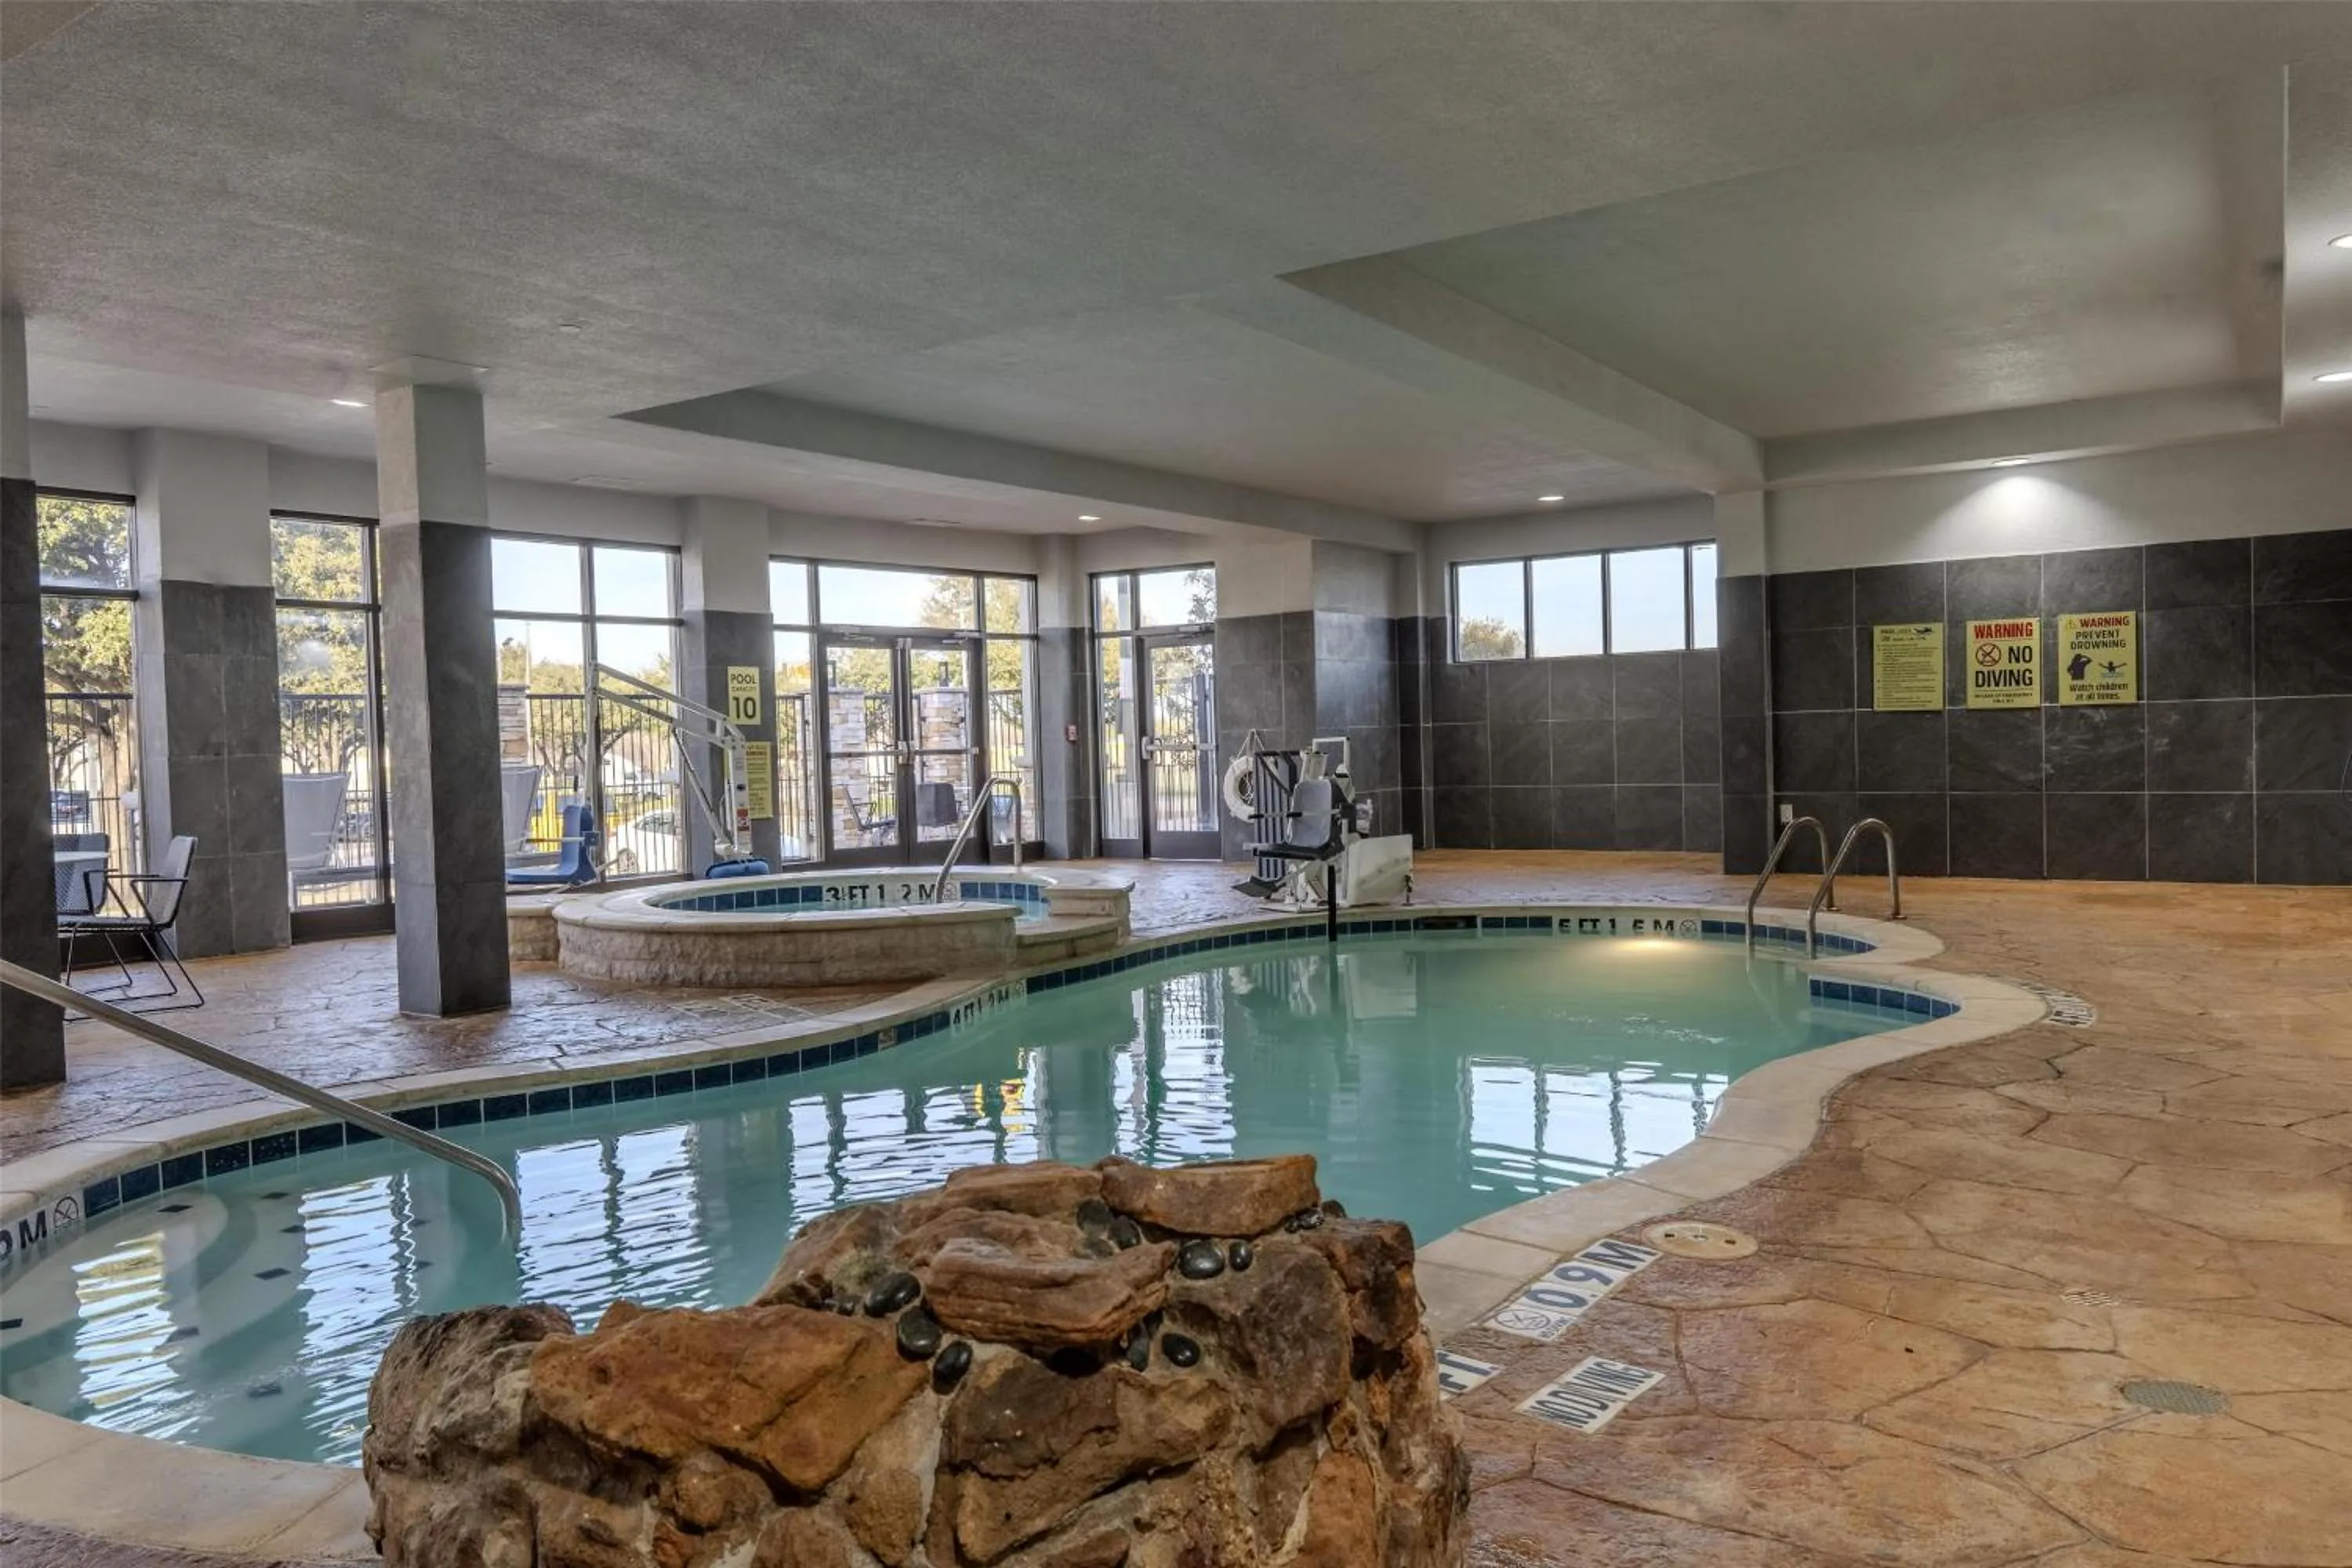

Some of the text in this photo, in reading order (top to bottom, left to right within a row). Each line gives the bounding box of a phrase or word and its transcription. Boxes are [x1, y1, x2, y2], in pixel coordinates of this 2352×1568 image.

[2080, 616, 2129, 627] WARNING
[1974, 622, 2033, 639] WARNING
[2076, 629, 2119, 640] PREVENT
[2071, 640, 2126, 650] DROWNING
[2008, 645, 2033, 664] NO
[731, 673, 757, 684] POOL
[1975, 669, 2033, 688] DIVING
[732, 696, 756, 719] 10
